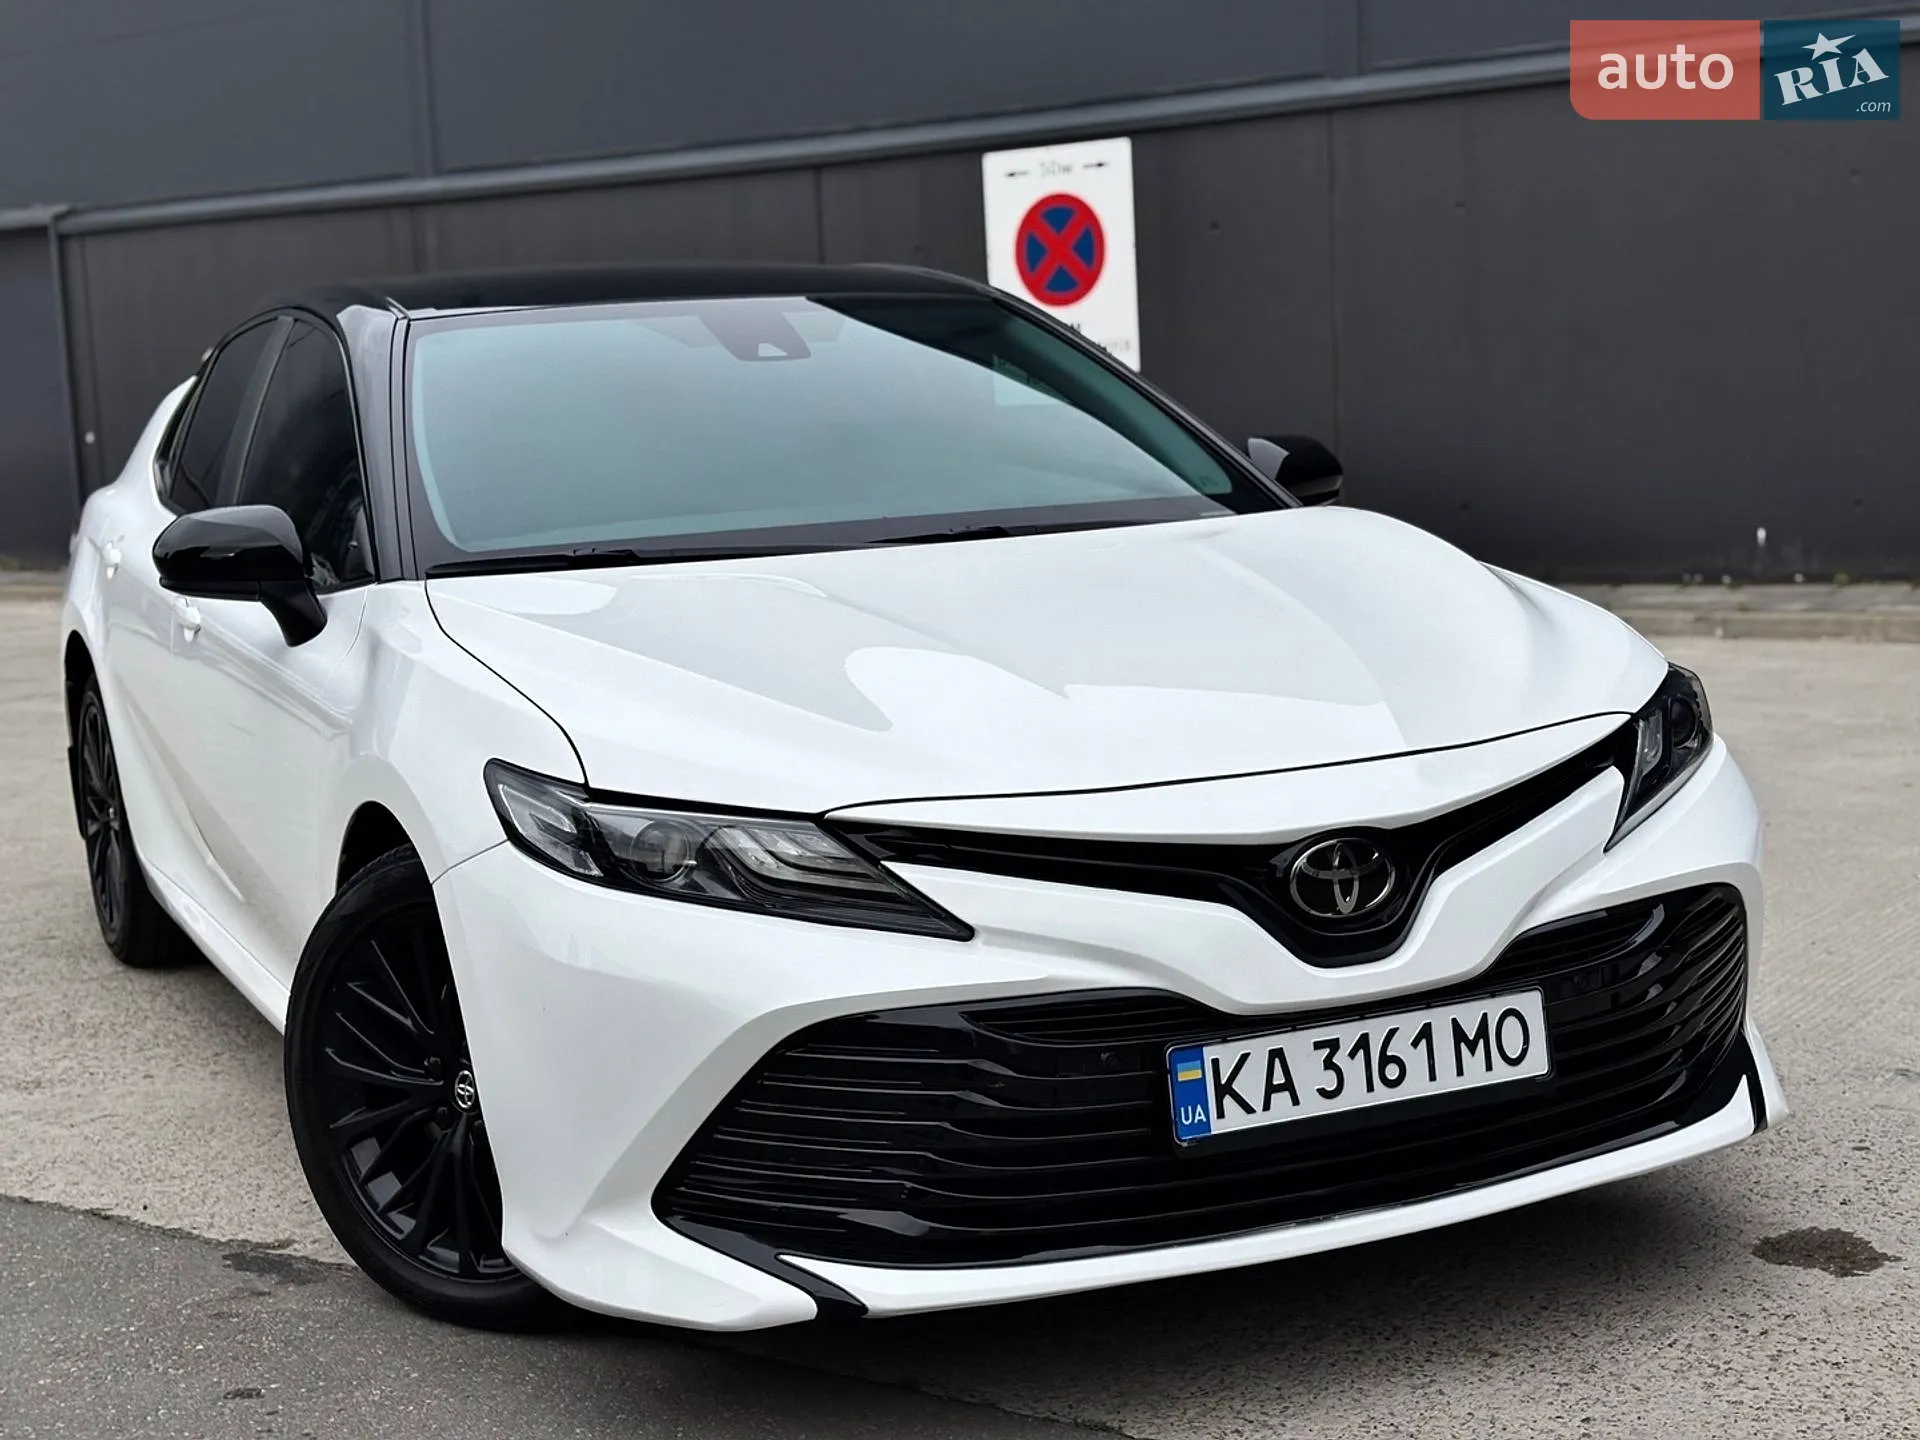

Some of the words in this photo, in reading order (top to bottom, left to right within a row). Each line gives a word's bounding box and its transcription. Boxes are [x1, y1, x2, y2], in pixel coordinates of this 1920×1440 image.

[1210, 1046, 1301, 1120] KA
[1312, 1020, 1438, 1100] 3161
[1450, 1006, 1531, 1078] MO
[1179, 1104, 1207, 1126] UA
